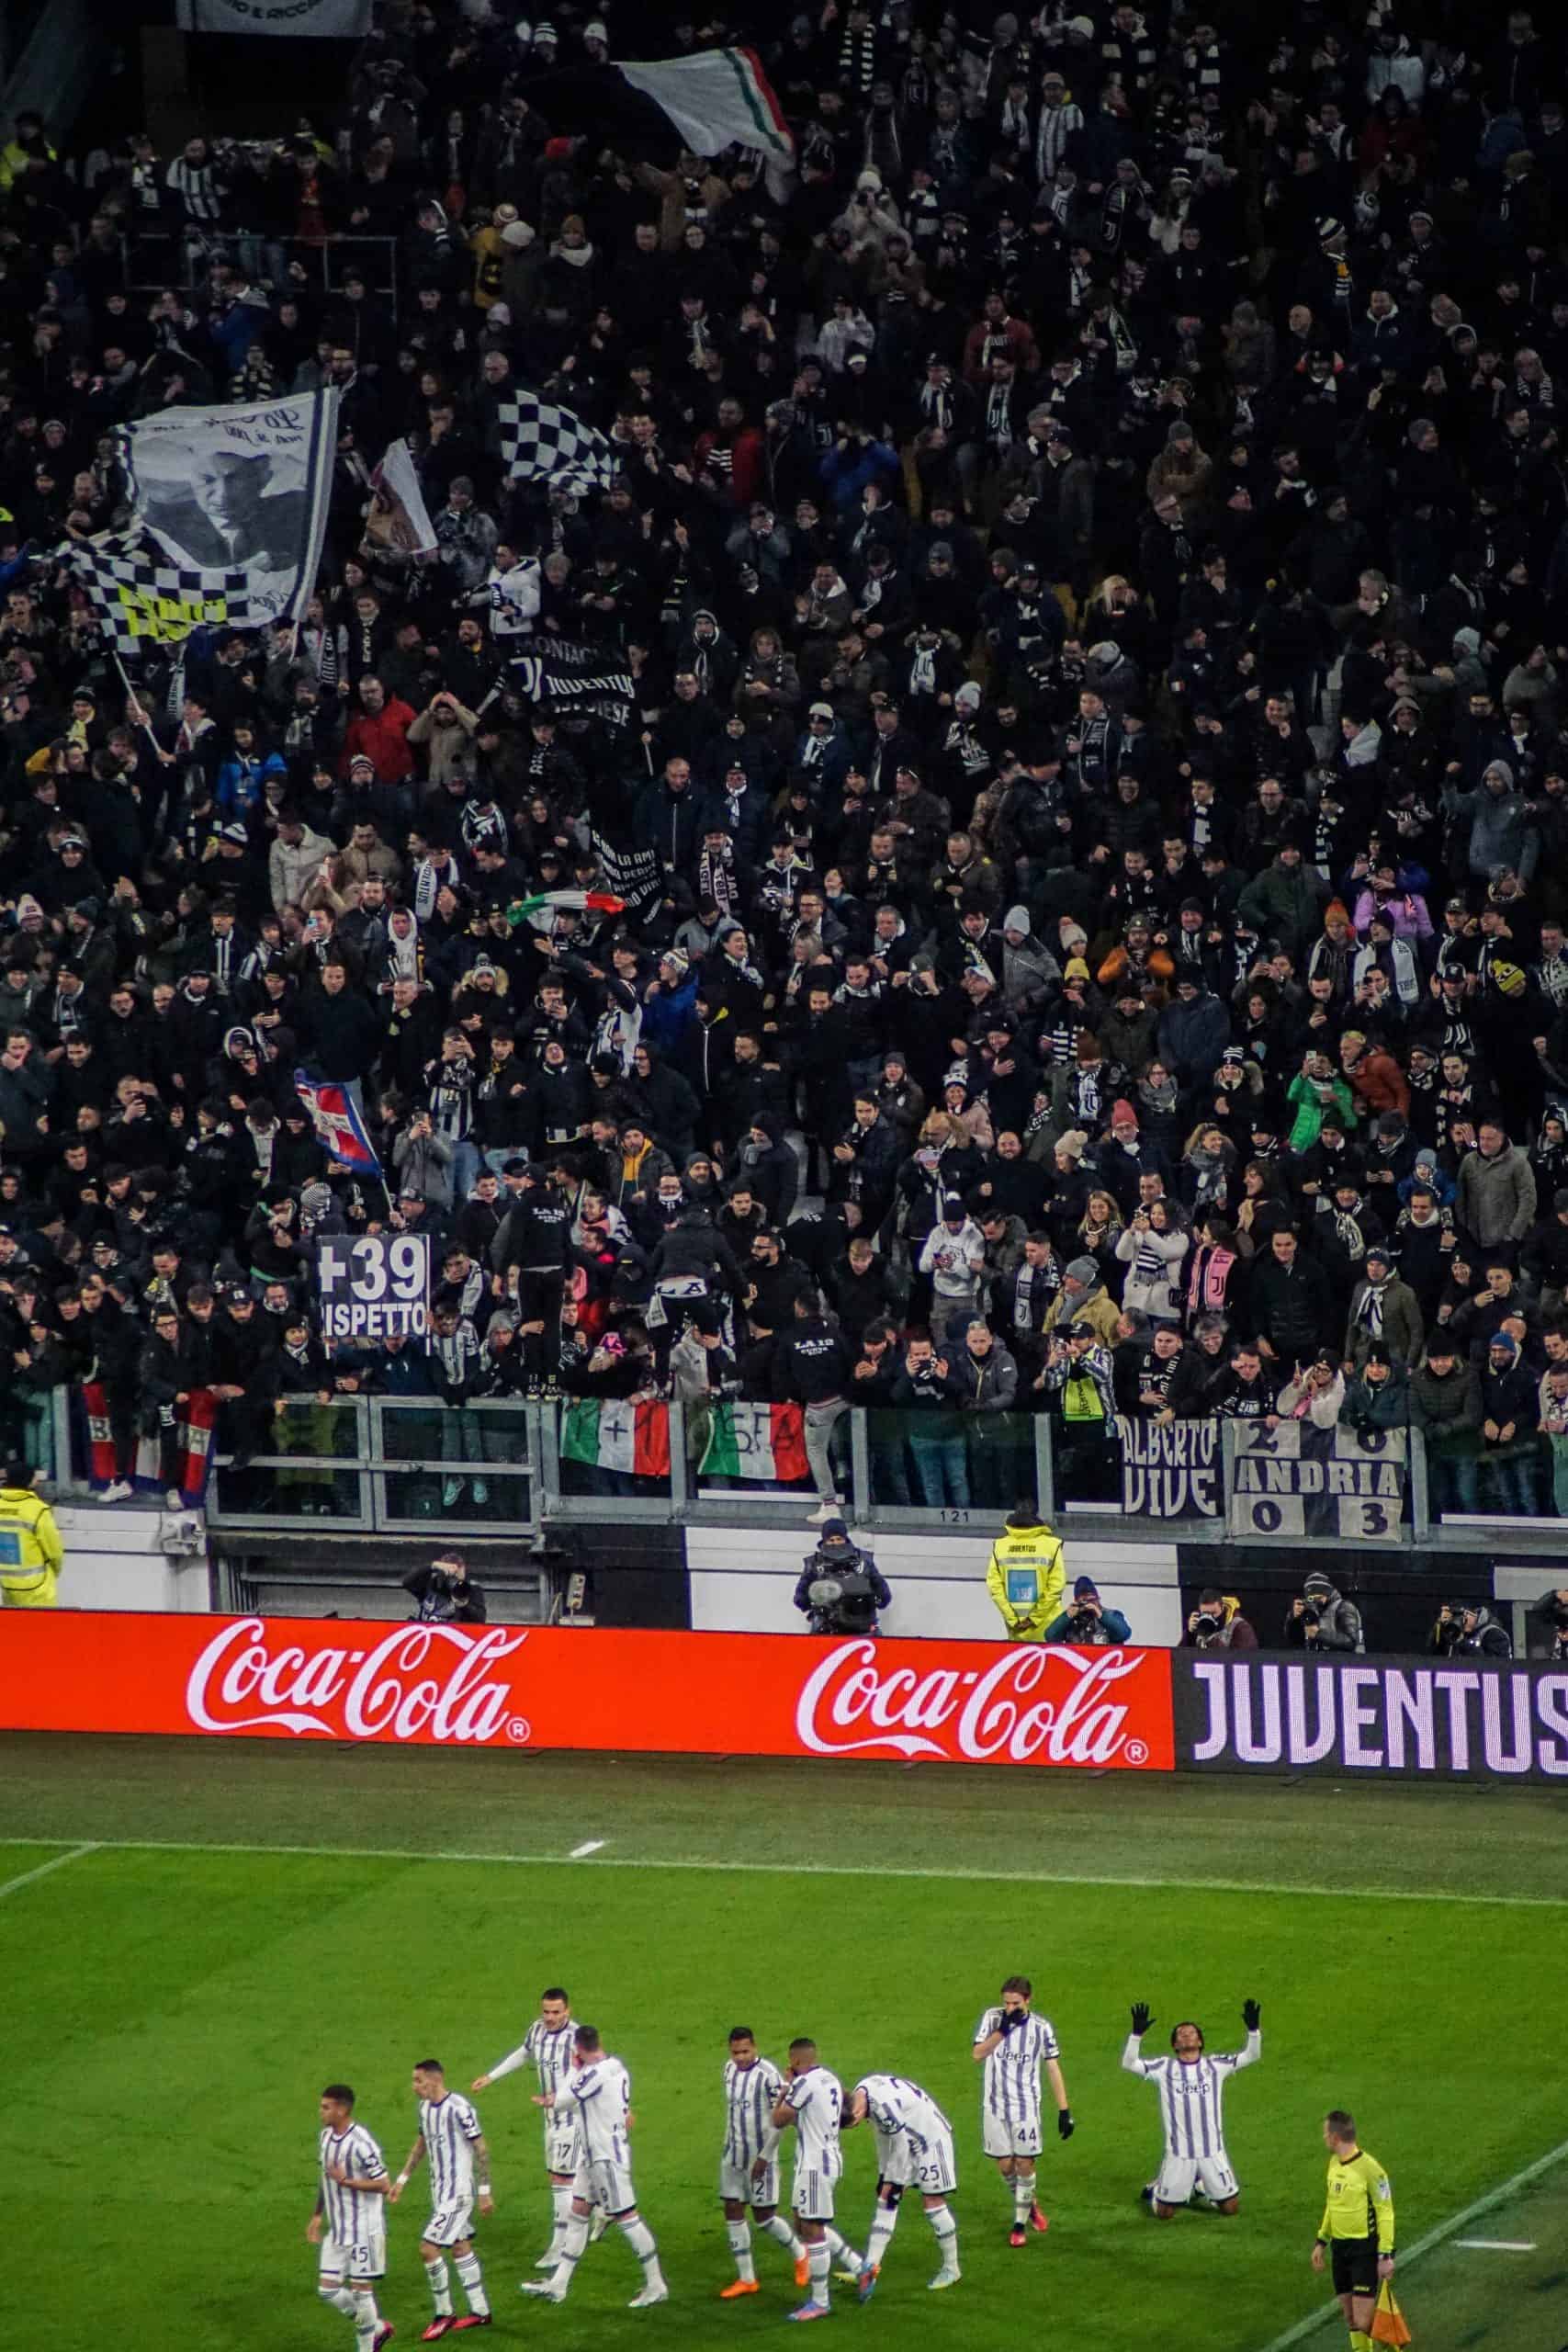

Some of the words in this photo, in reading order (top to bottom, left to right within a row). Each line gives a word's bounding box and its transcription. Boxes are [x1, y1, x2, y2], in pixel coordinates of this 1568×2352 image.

[319, 1236, 425, 1301] +39
[321, 1301, 426, 1337] ISPETTO
[1117, 1415, 1218, 1467] ALBERTO
[1123, 1465, 1218, 1517] VIVE
[1237, 1457, 1401, 1498] ANDRIA
[941, 1510, 970, 1523] 121
[1359, 1501, 1390, 1536] 3
[186, 1618, 530, 1742] Coca-Cola
[795, 1639, 1147, 1763] Coca-Cola
[1194, 1662, 1568, 1774] JUVENTUS
[996, 2045, 1032, 2064] Jeep
[1175, 2081, 1212, 2096] Jeep
[557, 2143, 572, 2159] 17
[1017, 2127, 1038, 2143] 44
[919, 2164, 941, 2183] 25
[798, 2189, 808, 2205] 3
